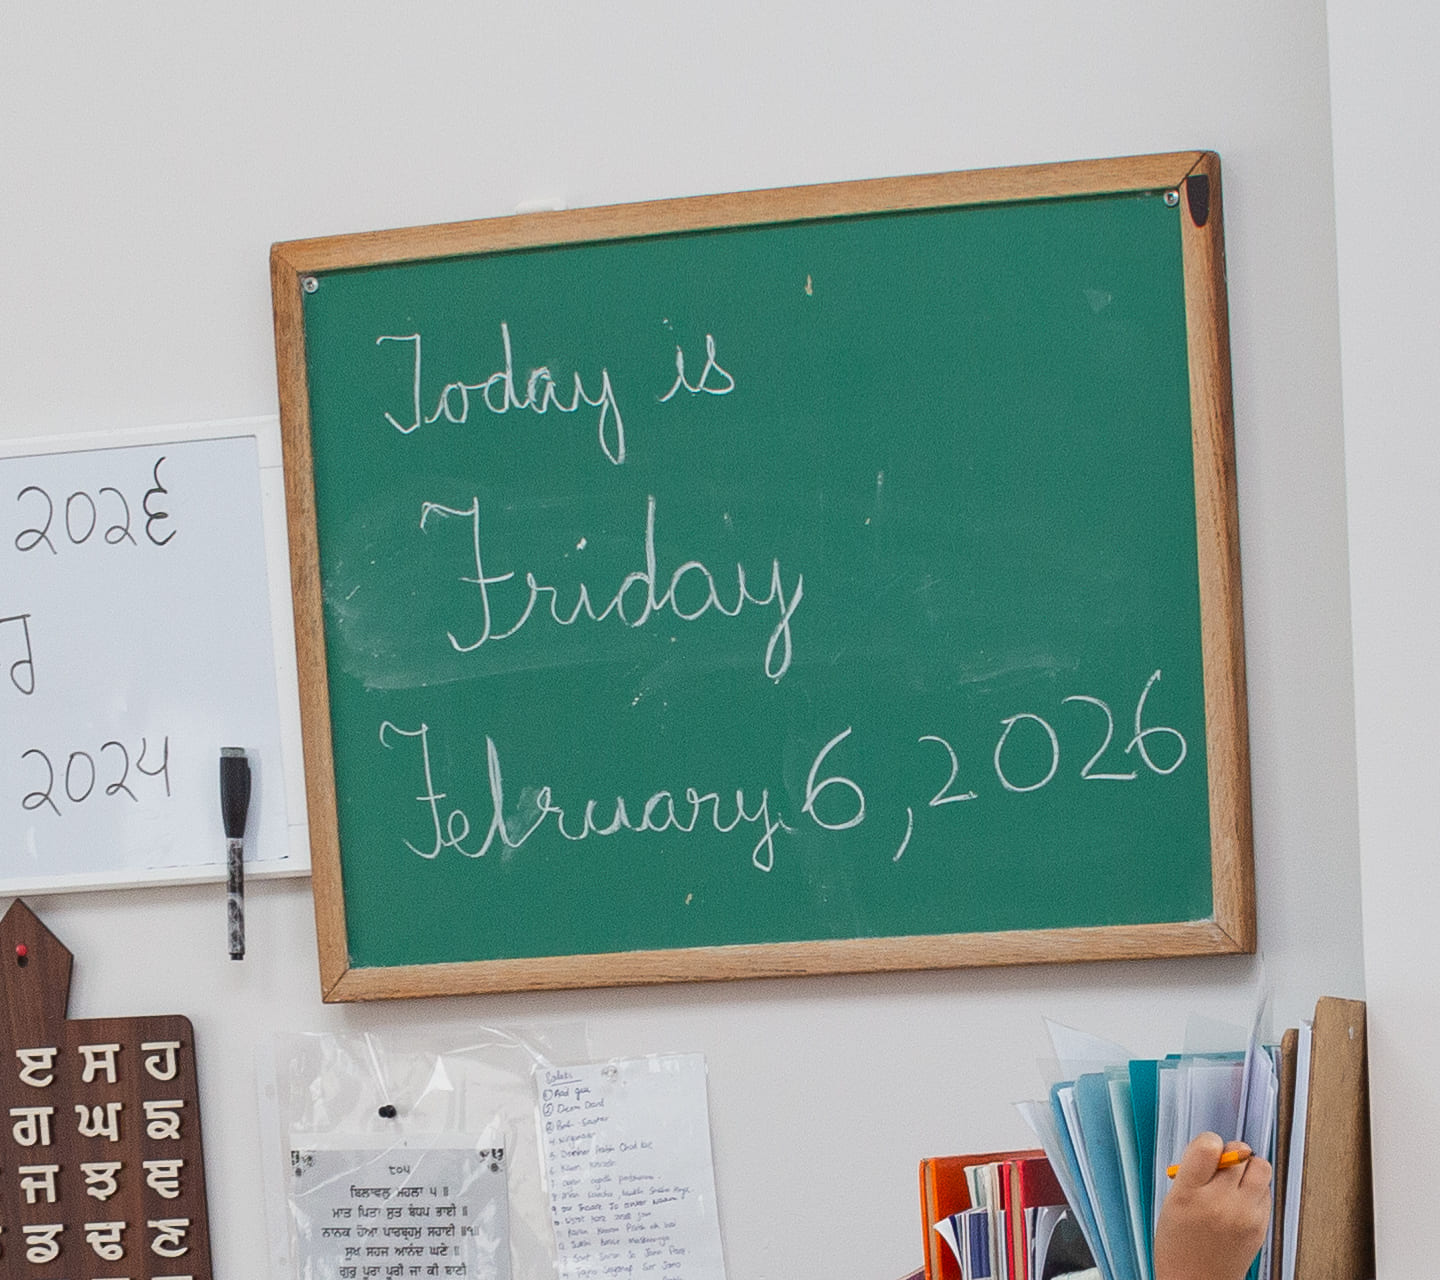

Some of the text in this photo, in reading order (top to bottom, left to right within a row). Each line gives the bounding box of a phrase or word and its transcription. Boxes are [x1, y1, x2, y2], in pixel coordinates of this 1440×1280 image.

[376, 318, 736, 466] Today is
[420, 496, 804, 678] Friday
[378, 720, 794, 872] February
[918, 669, 1188, 806] 2026
[78, 1043, 120, 1083] ਸ
[141, 1041, 180, 1081] ਹ
[9, 1106, 54, 1146] ਗ
[74, 1102, 122, 1142] ਘ
[18, 1164, 59, 1204] ਜ
[80, 1161, 122, 1201] ਝ
[22, 1223, 64, 1264] ਡ
[84, 1221, 126, 1261] ਢ
[147, 1218, 190, 1258] ਣ
